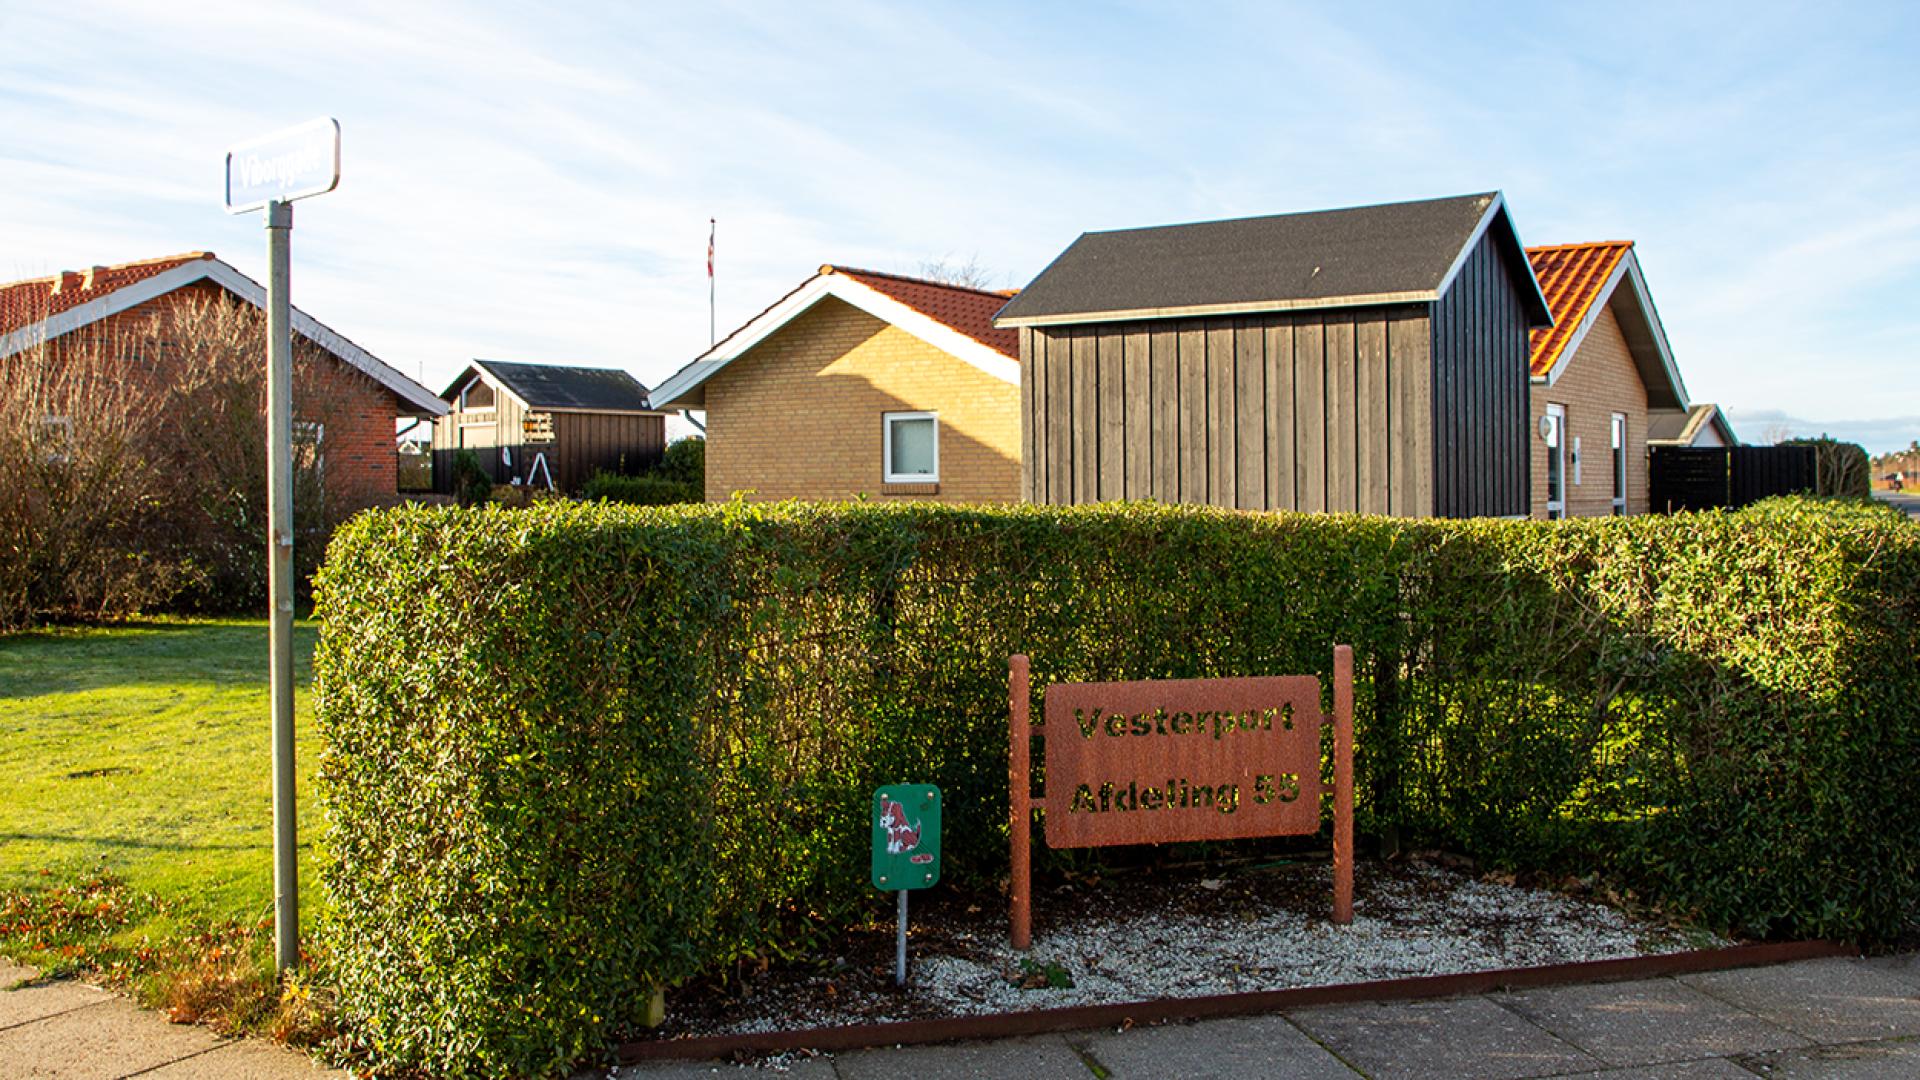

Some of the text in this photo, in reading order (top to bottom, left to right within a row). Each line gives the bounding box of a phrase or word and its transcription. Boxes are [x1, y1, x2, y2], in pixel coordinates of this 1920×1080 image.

[1074, 702, 1296, 739] Vesterport
[1069, 773, 1299, 814] Afdeling 55
